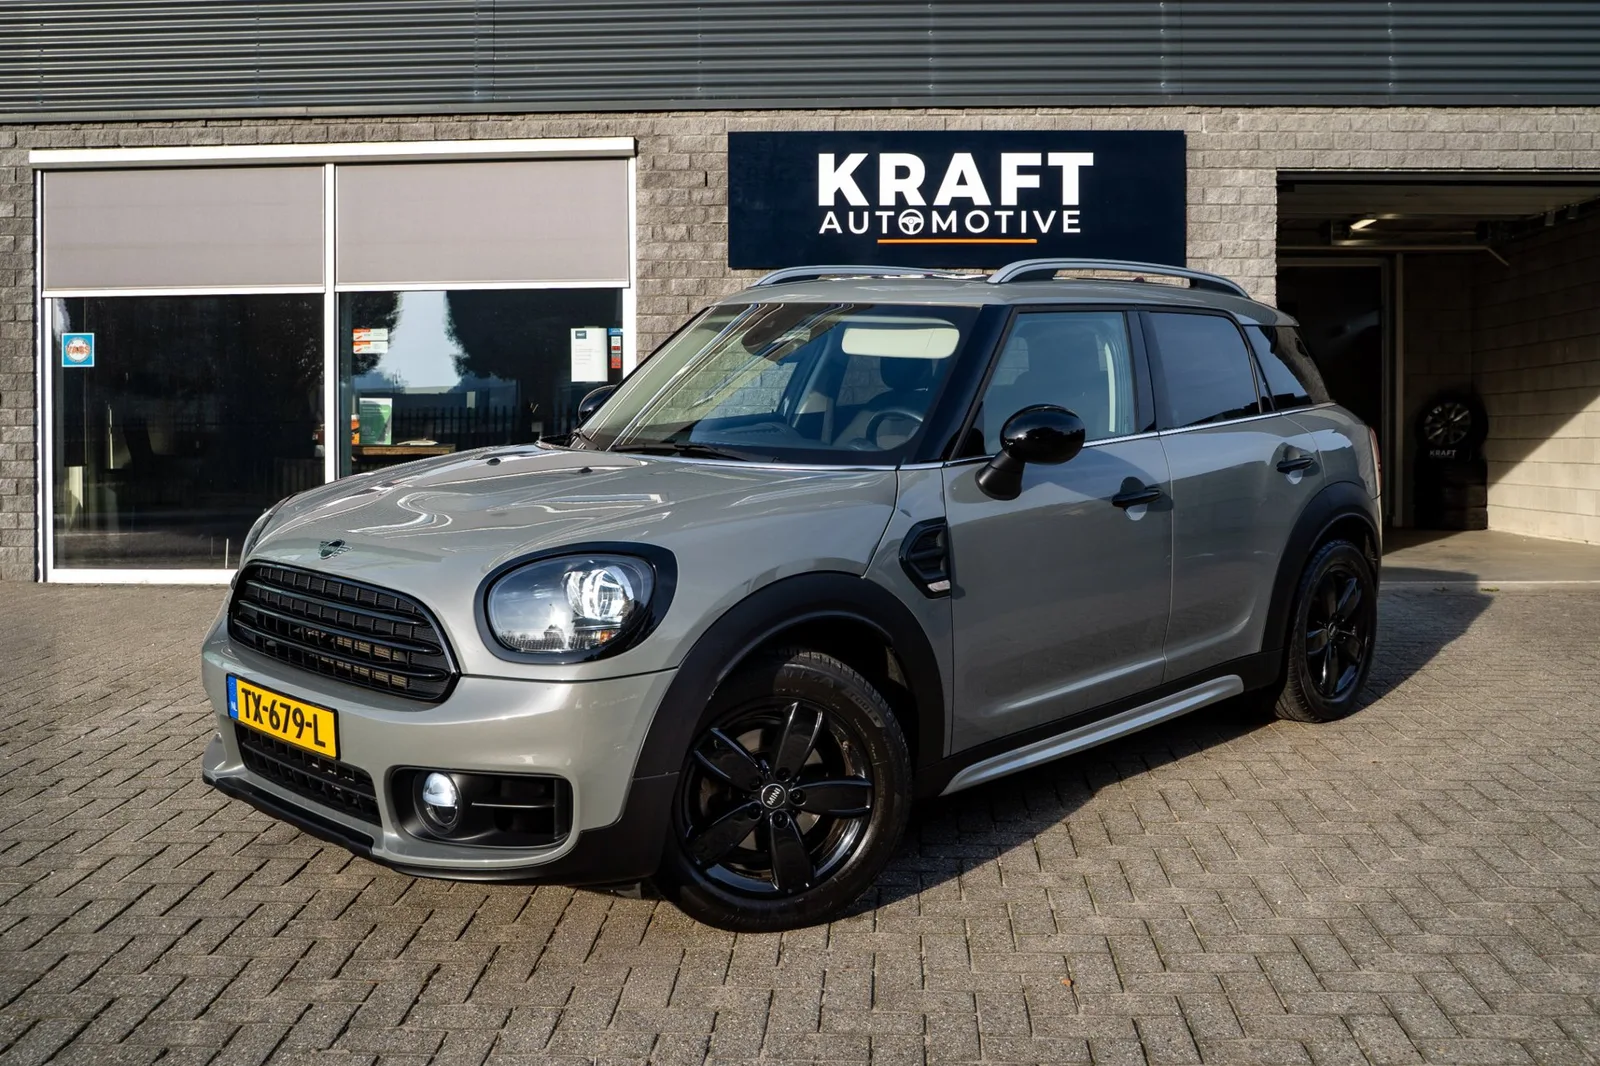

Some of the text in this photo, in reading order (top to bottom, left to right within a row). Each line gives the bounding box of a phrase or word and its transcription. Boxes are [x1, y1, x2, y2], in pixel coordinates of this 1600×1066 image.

[818, 152, 1094, 206] KRAFT
[819, 208, 1081, 235] AUTOMOTIVE
[231, 701, 237, 711] NL
[241, 688, 326, 747] TX-679-L
[767, 788, 781, 805] MINI
